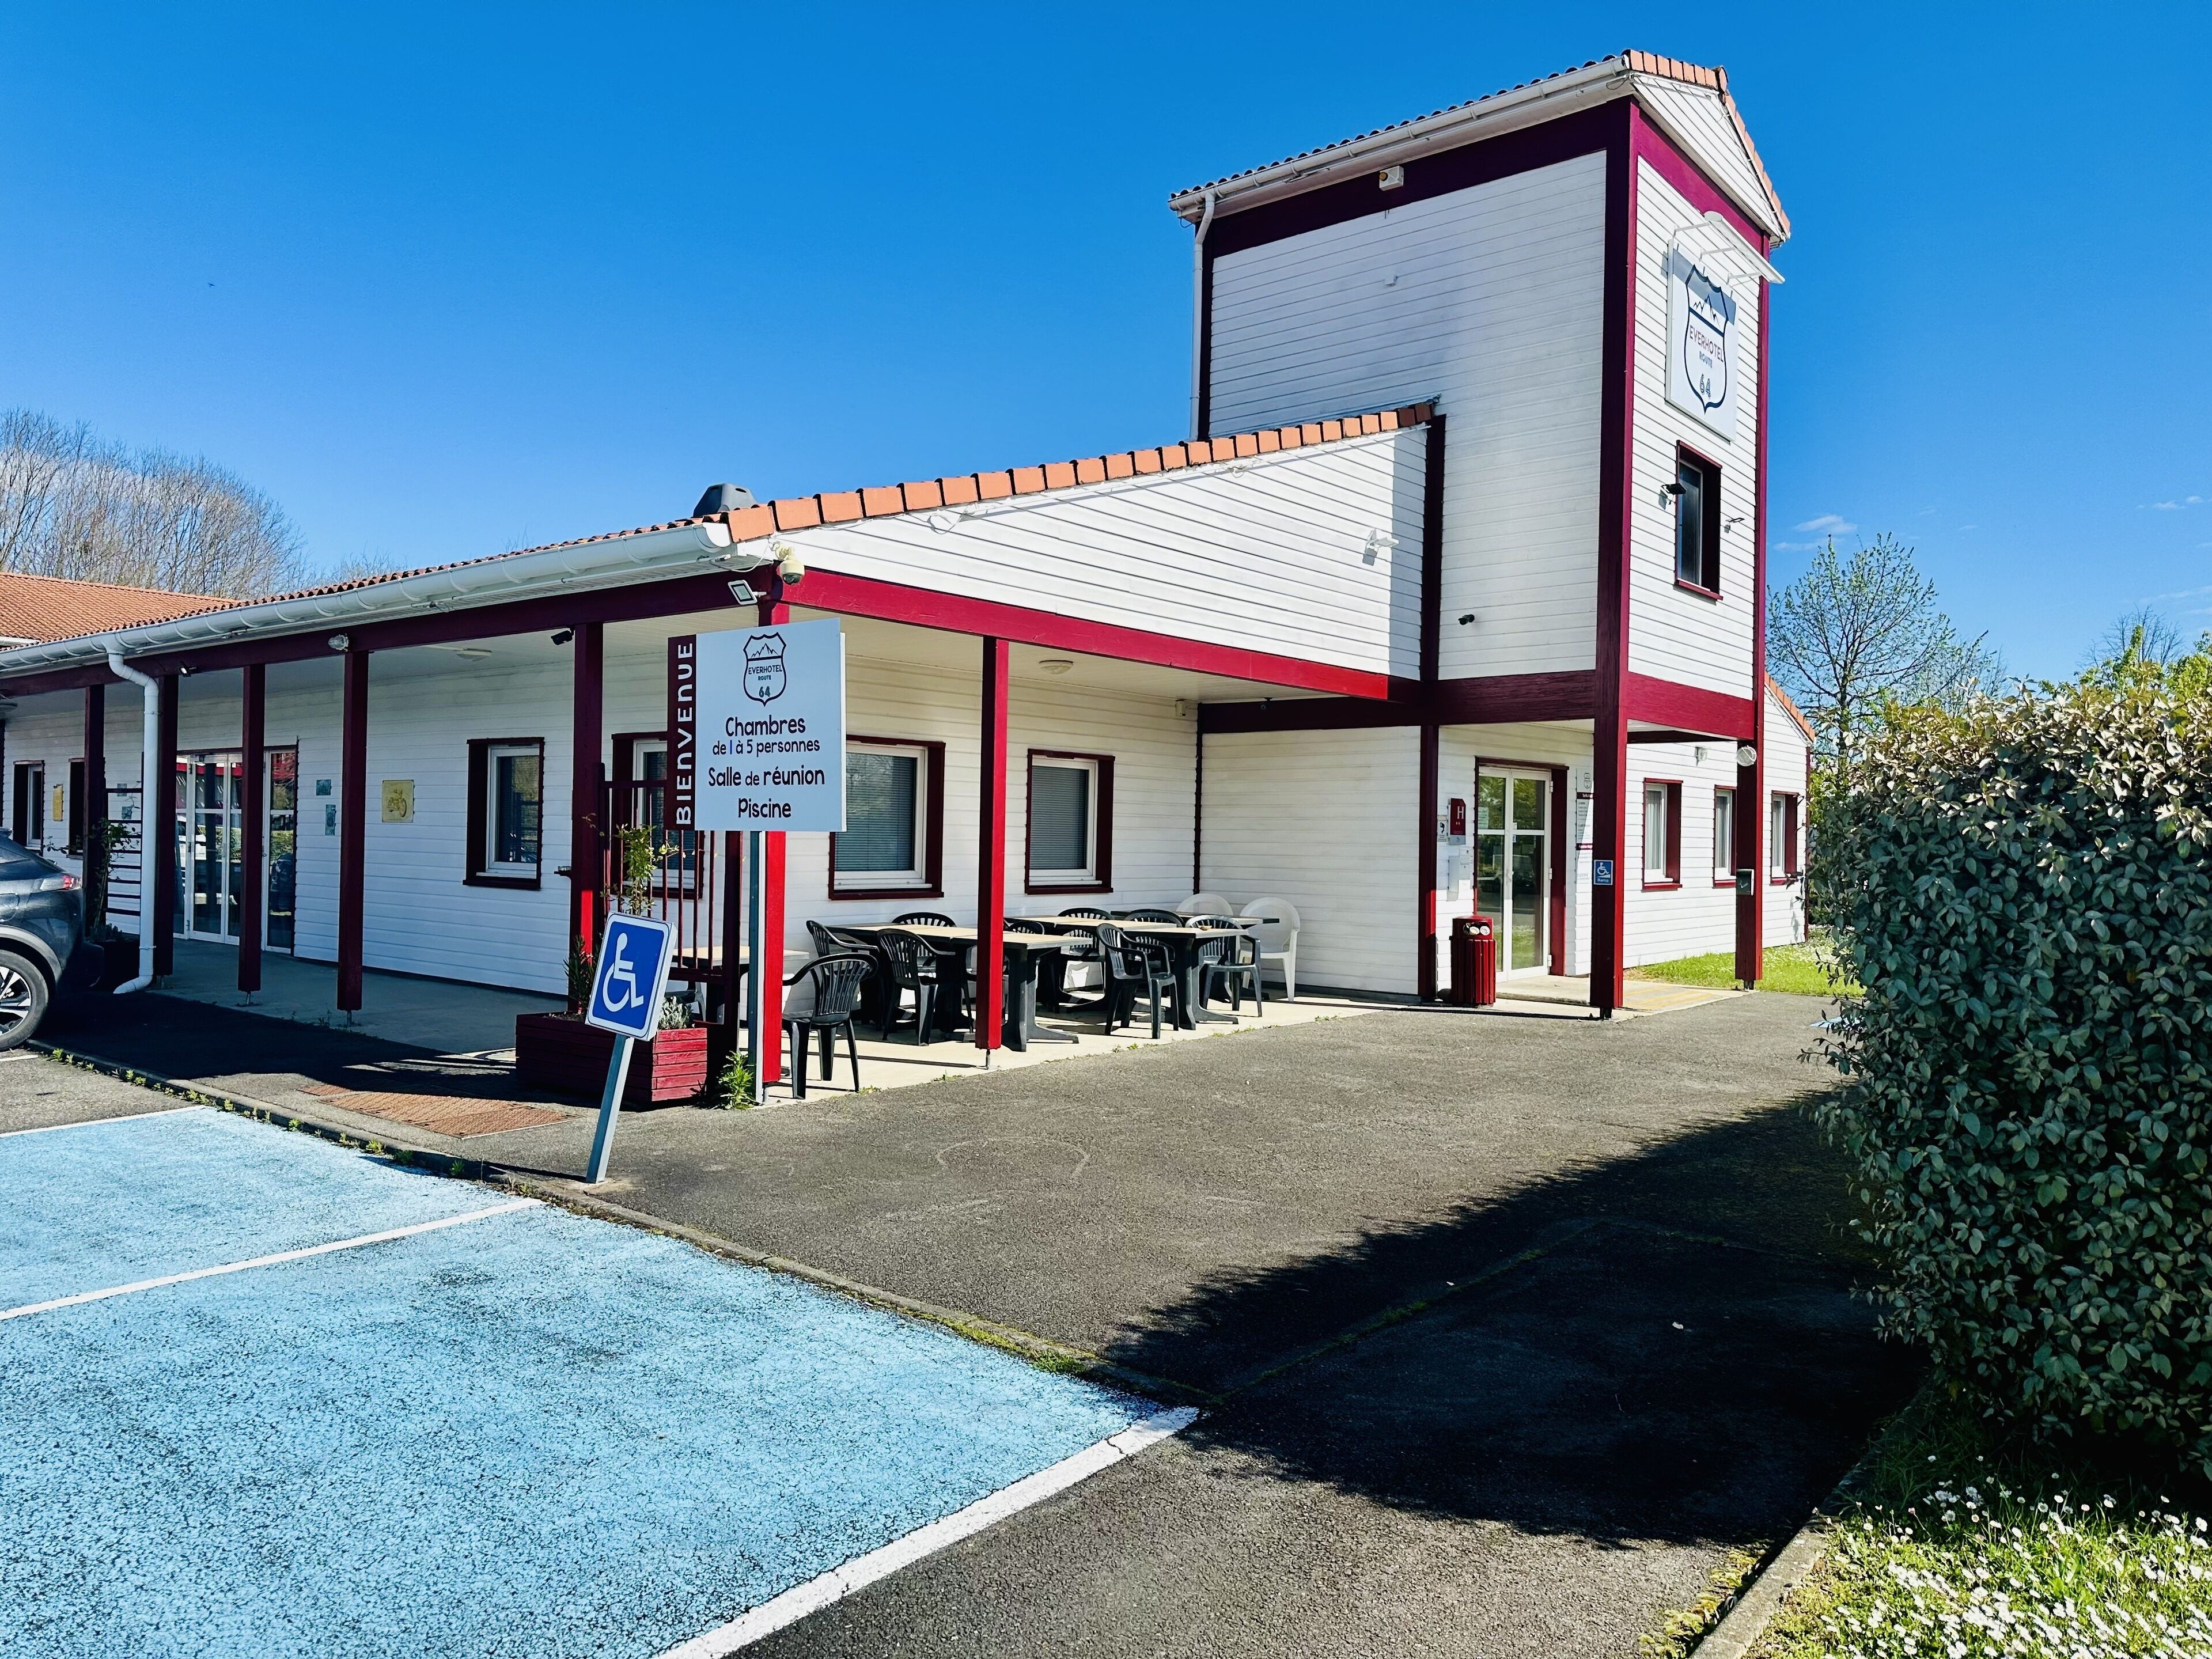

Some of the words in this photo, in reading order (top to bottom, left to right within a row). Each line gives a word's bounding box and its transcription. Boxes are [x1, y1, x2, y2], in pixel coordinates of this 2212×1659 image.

[1690, 325, 1724, 362] EVERHOTEL
[1699, 351, 1713, 369] ROUTE
[1699, 373, 1711, 399] 64
[748, 665, 783, 675] EVERHOTEL
[759, 685, 771, 698] 64
[726, 715, 806, 736] Chambres
[713, 741, 726, 755] de
[736, 739, 743, 754] à
[747, 739, 753, 753] 5
[756, 738, 820, 757] personnes
[709, 767, 741, 786] Salle
[745, 771, 759, 786] de
[763, 766, 825, 786] réunion
[738, 798, 791, 818] Piscine
[1457, 806, 1464, 820] H
